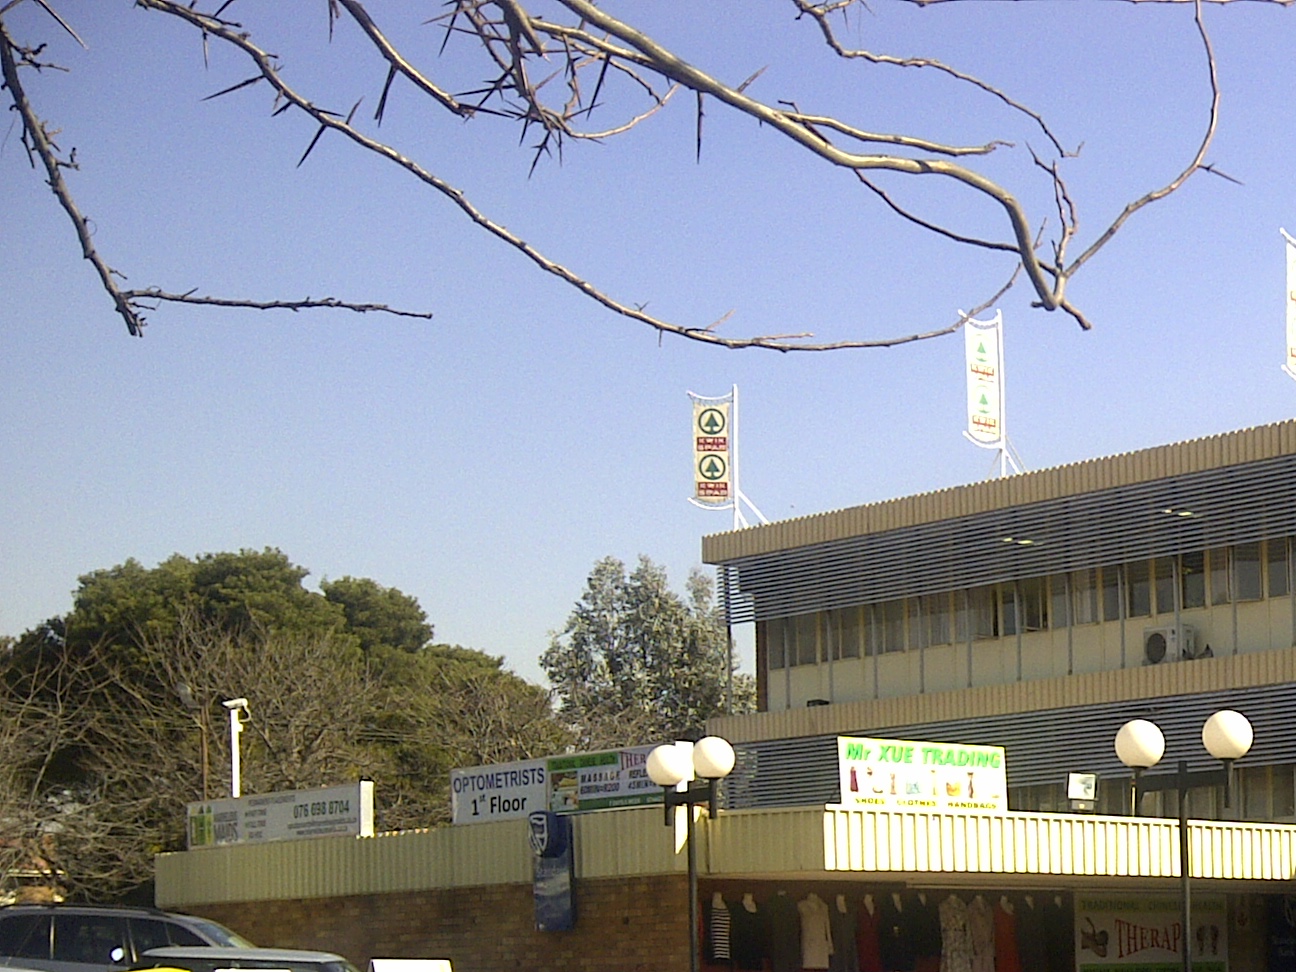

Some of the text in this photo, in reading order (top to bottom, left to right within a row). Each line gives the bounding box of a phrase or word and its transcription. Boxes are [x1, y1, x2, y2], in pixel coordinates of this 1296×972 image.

[845, 743, 1001, 769] Mr XUE TRADING
[453, 767, 546, 793] OPTOMETRISTS
[490, 795, 528, 814] Floor
